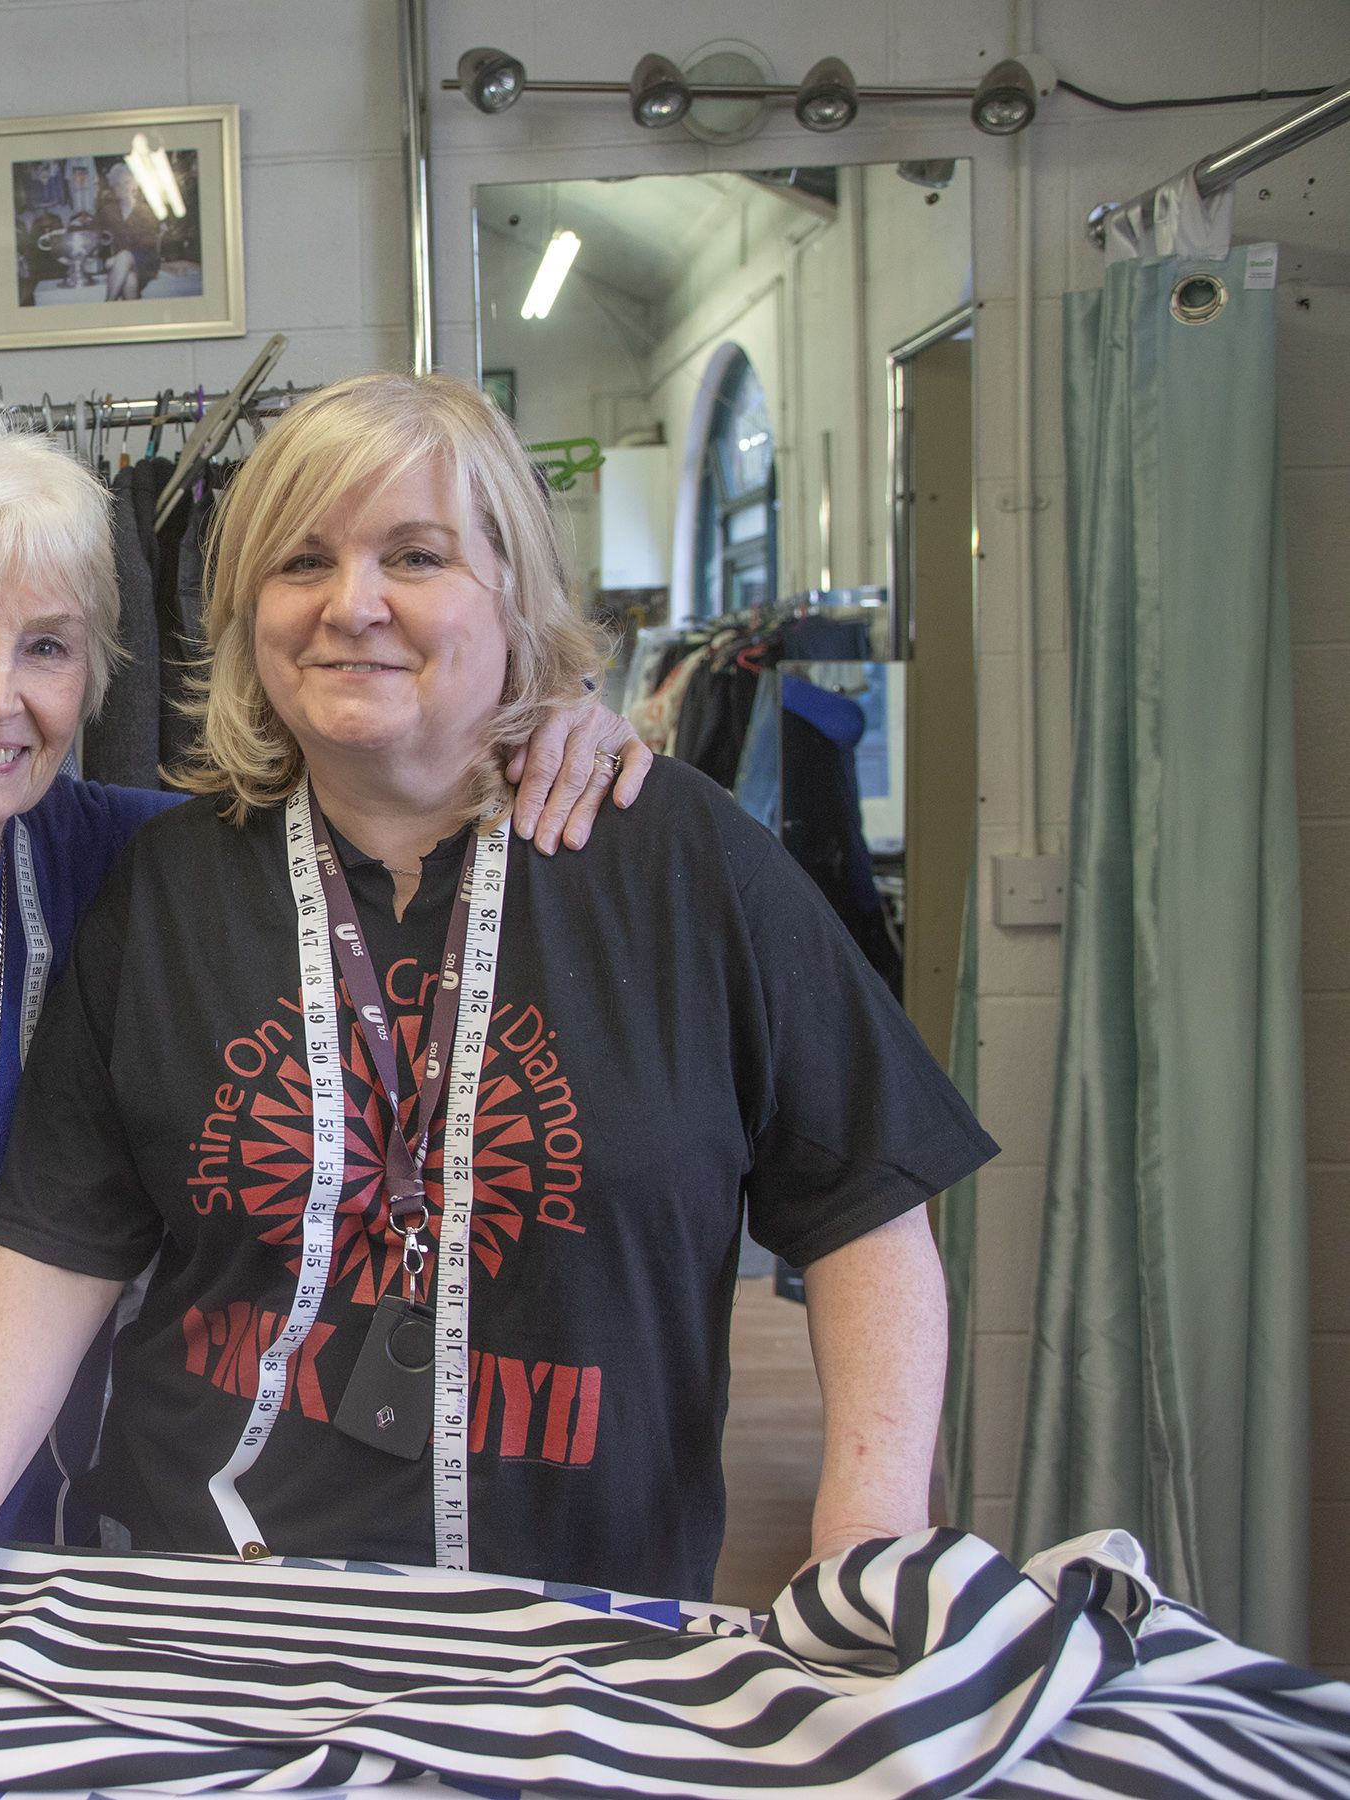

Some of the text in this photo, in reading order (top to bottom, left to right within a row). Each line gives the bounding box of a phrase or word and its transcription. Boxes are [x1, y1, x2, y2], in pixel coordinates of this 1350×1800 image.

[290, 822, 303, 843] 44
[488, 830, 505, 852] 30
[21, 871, 29, 879] 113
[292, 857, 308, 877] 45
[23, 885, 31, 893] 114
[484, 869, 501, 892] 29
[299, 894, 316, 915] 46
[479, 909, 497, 932] 28
[302, 928, 318, 947] 47
[475, 949, 493, 972] 27
[305, 965, 322, 985] 48
[471, 990, 488, 1013] 26
[28, 1010, 36, 1018] 123
[308, 1002, 325, 1024] 49
[311, 1042, 328, 1064] 50
[465, 1031, 482, 1054] 25
[316, 1078, 333, 1099] 51
[459, 1071, 476, 1094] 24
[187, 1082, 245, 1216] Shine
[224, 1019, 293, 1078] On
[499, 1003, 586, 1234] Diamond
[455, 1113, 470, 1137] 23
[318, 1118, 334, 1142] 52
[318, 1161, 334, 1185] 53
[454, 1156, 468, 1180] 22
[308, 1202, 326, 1224] 54
[452, 1201, 468, 1223] 21
[307, 1243, 322, 1267] 55
[449, 1242, 464, 1267] 20
[298, 1286, 315, 1308] 56
[448, 1284, 463, 1307] 19
[283, 1325, 302, 1342] 57
[446, 1328, 463, 1352] 18
[265, 1352, 282, 1371] 58
[446, 1371, 463, 1394] 17
[259, 1390, 276, 1411] 59
[244, 1426, 262, 1446] 60
[445, 1415, 462, 1439] 16
[445, 1459, 461, 1482] 15
[445, 1500, 462, 1520] 14
[446, 1534, 463, 1549] 13
